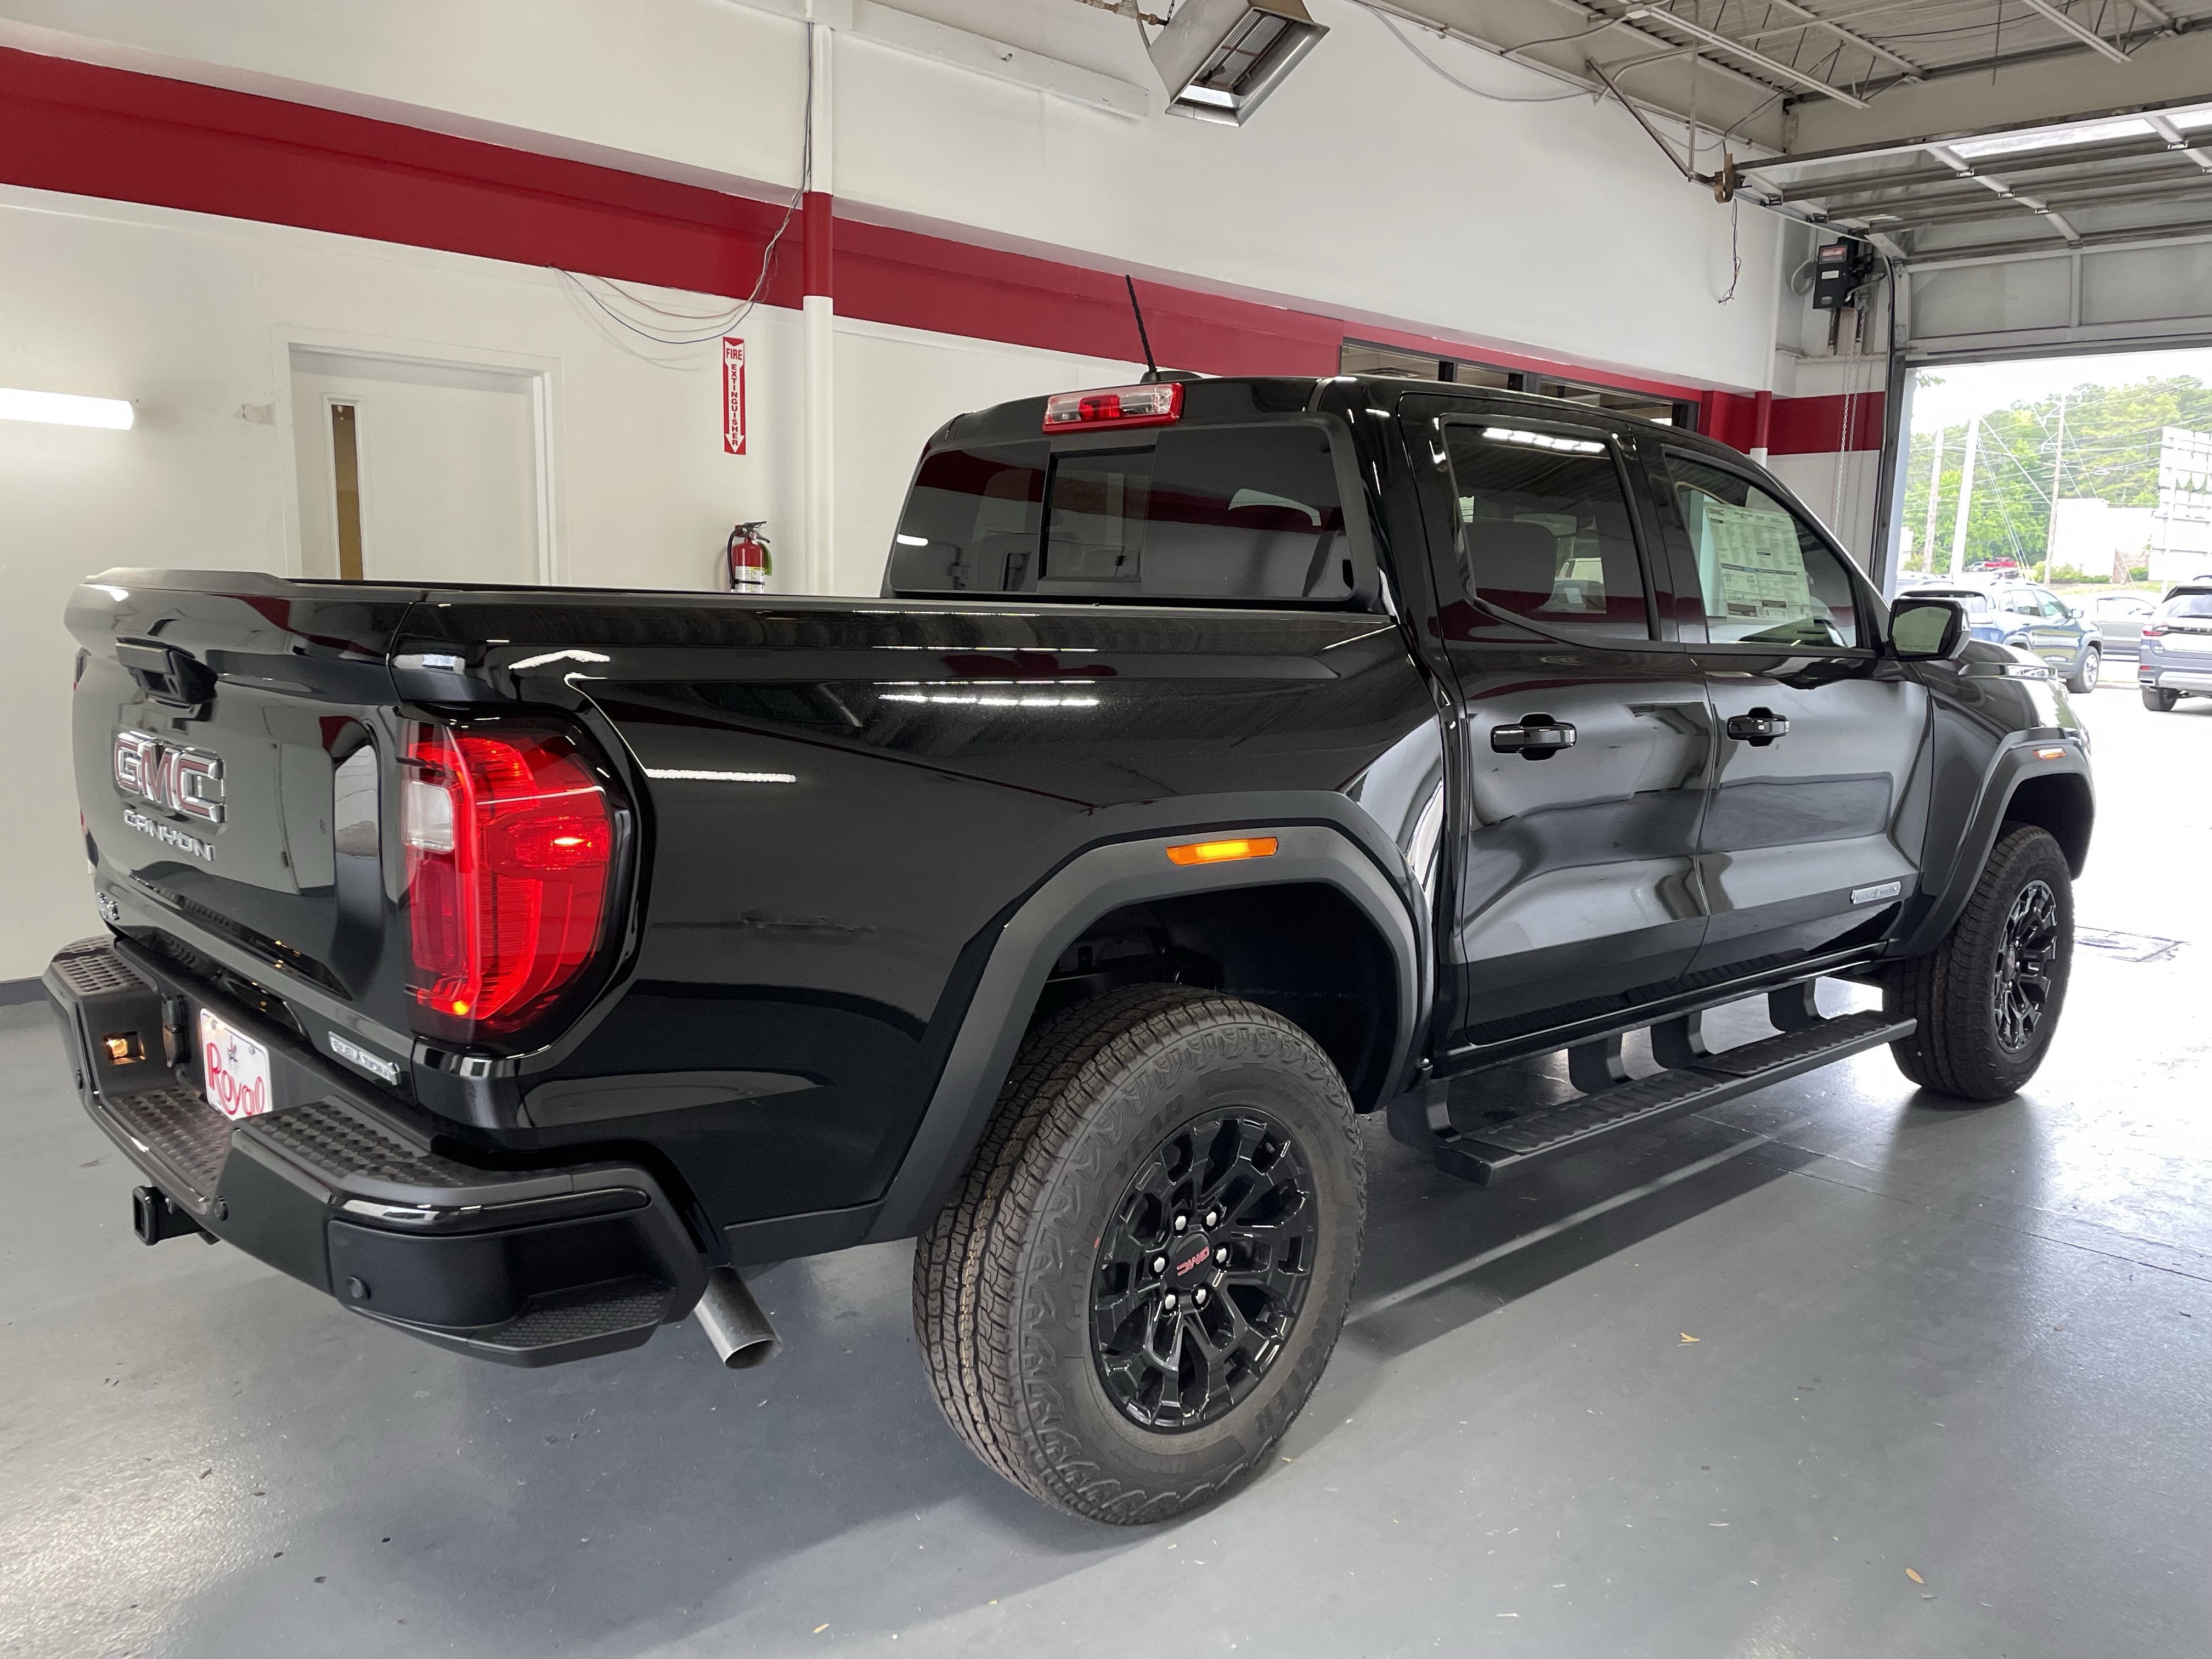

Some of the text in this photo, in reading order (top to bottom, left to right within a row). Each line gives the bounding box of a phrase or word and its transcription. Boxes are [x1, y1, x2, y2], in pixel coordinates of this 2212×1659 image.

[726, 348, 742, 360] FIRE
[730, 363, 739, 446] EXTINGUISHER
[114, 731, 227, 823] GMC
[123, 808, 216, 862] CANYON
[206, 1042, 265, 1116] Royal
[1176, 1246, 1210, 1277] GMC
